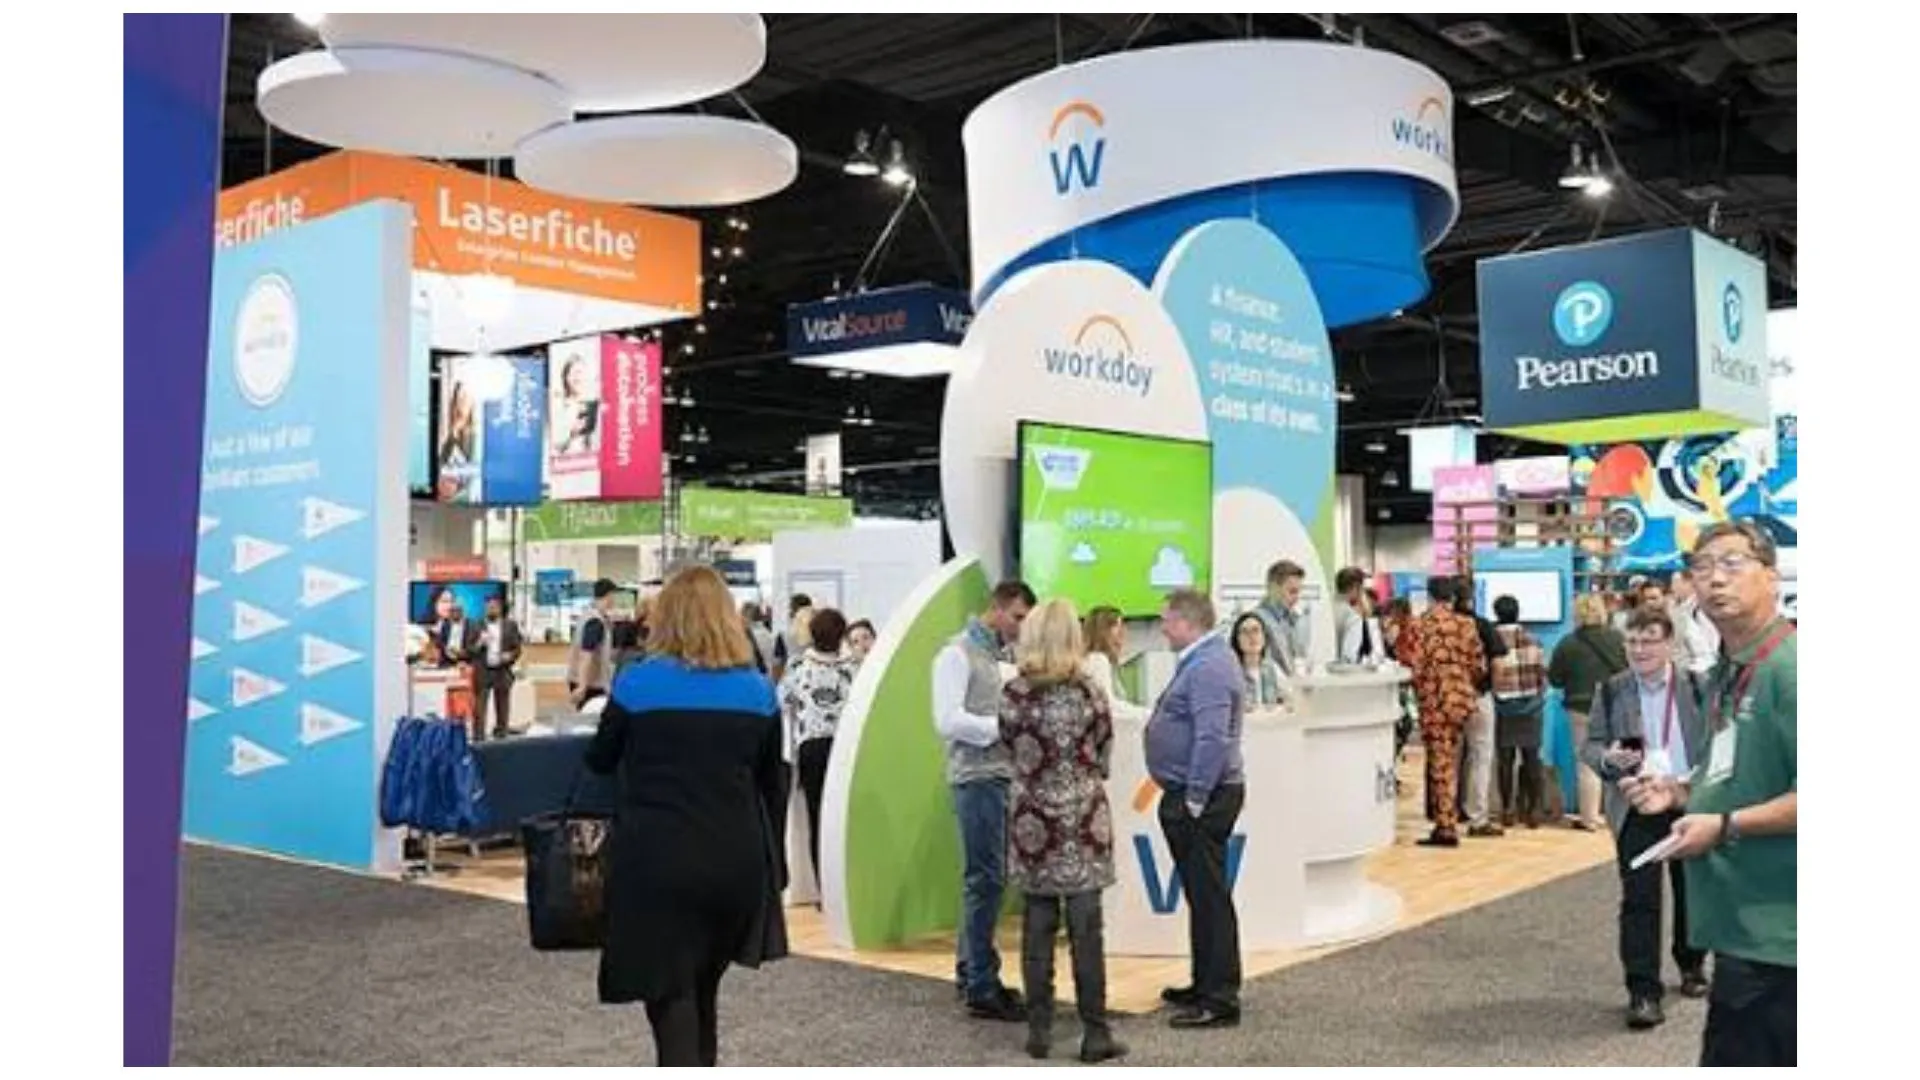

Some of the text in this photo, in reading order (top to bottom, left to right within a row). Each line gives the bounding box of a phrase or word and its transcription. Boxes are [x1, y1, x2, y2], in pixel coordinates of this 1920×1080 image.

[439, 186, 638, 263] Laserfiche
[1044, 345, 1154, 398] workday
[1515, 349, 1661, 391] Pearson
